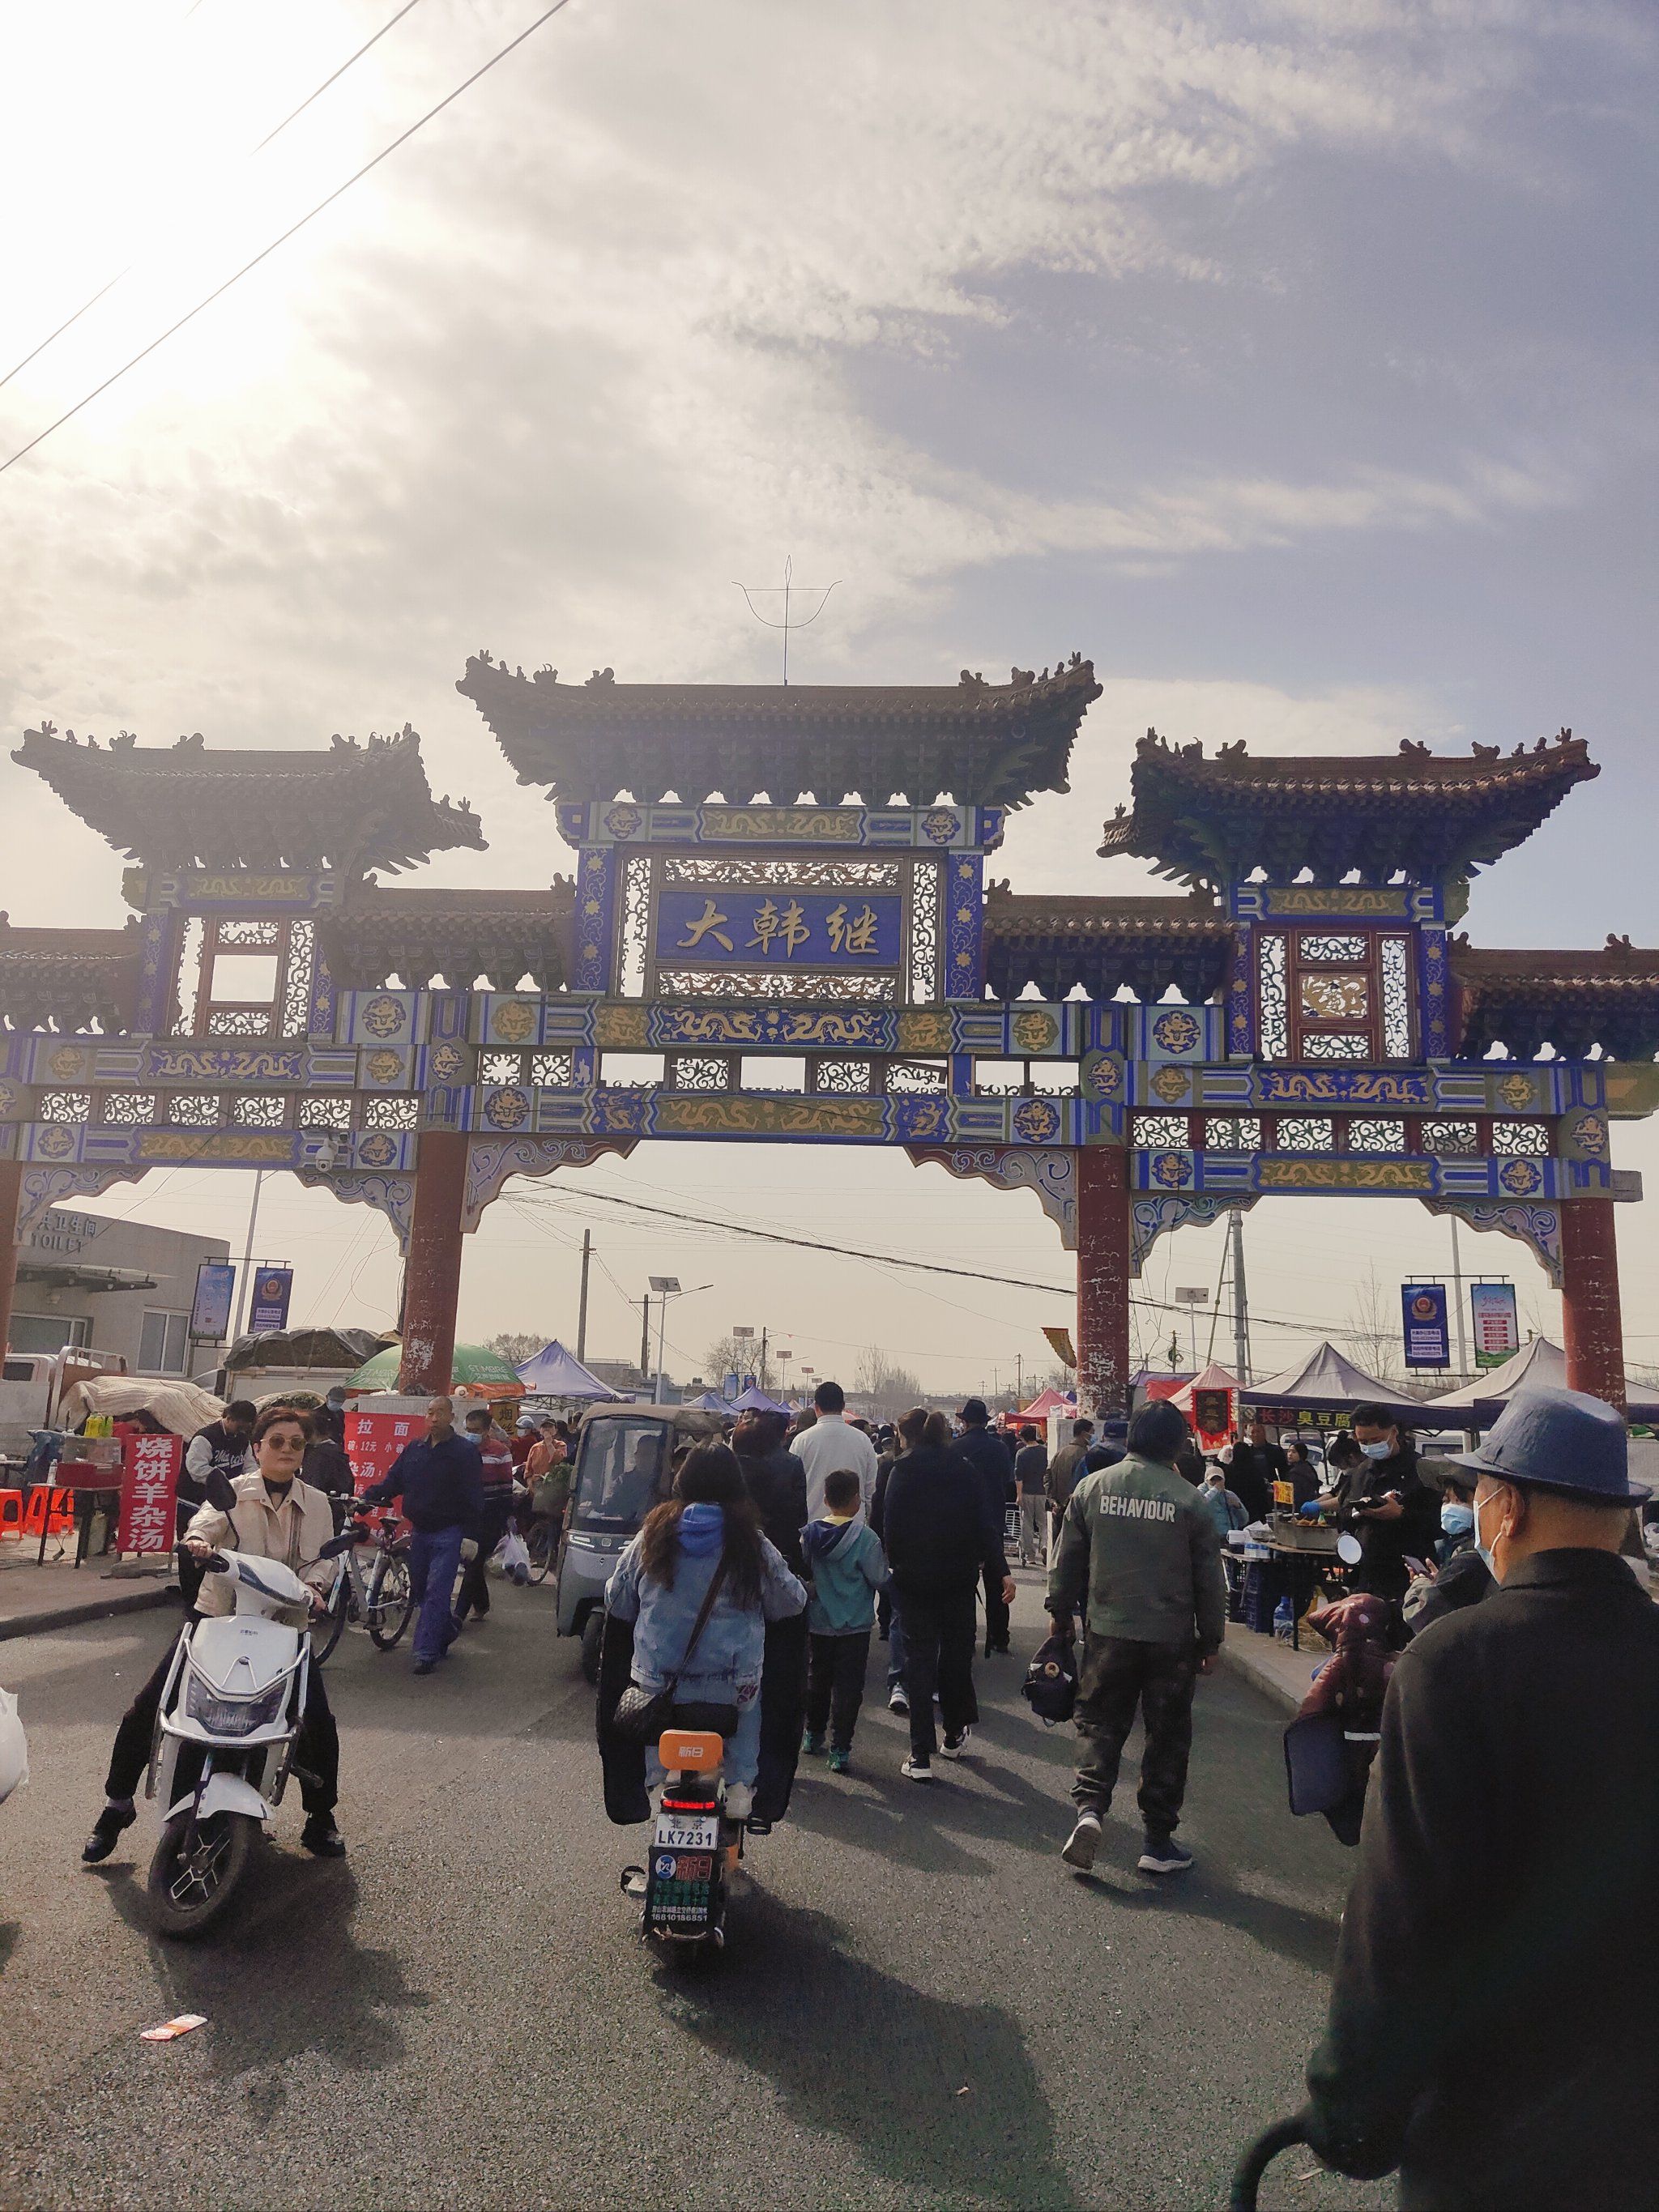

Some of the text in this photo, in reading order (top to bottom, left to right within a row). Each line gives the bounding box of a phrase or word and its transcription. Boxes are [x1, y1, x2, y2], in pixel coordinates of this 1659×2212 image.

[676, 898, 880, 958] 大韩继
[32, 1233, 82, 1252] TOILET
[357, 1419, 410, 1436] 拉面
[128, 1437, 173, 1549] 烧饼羊杂汤
[1100, 1495, 1175, 1523] BEHAVIOUR
[678, 1745, 704, 1758] 新日
[658, 1830, 713, 1847] LK7231
